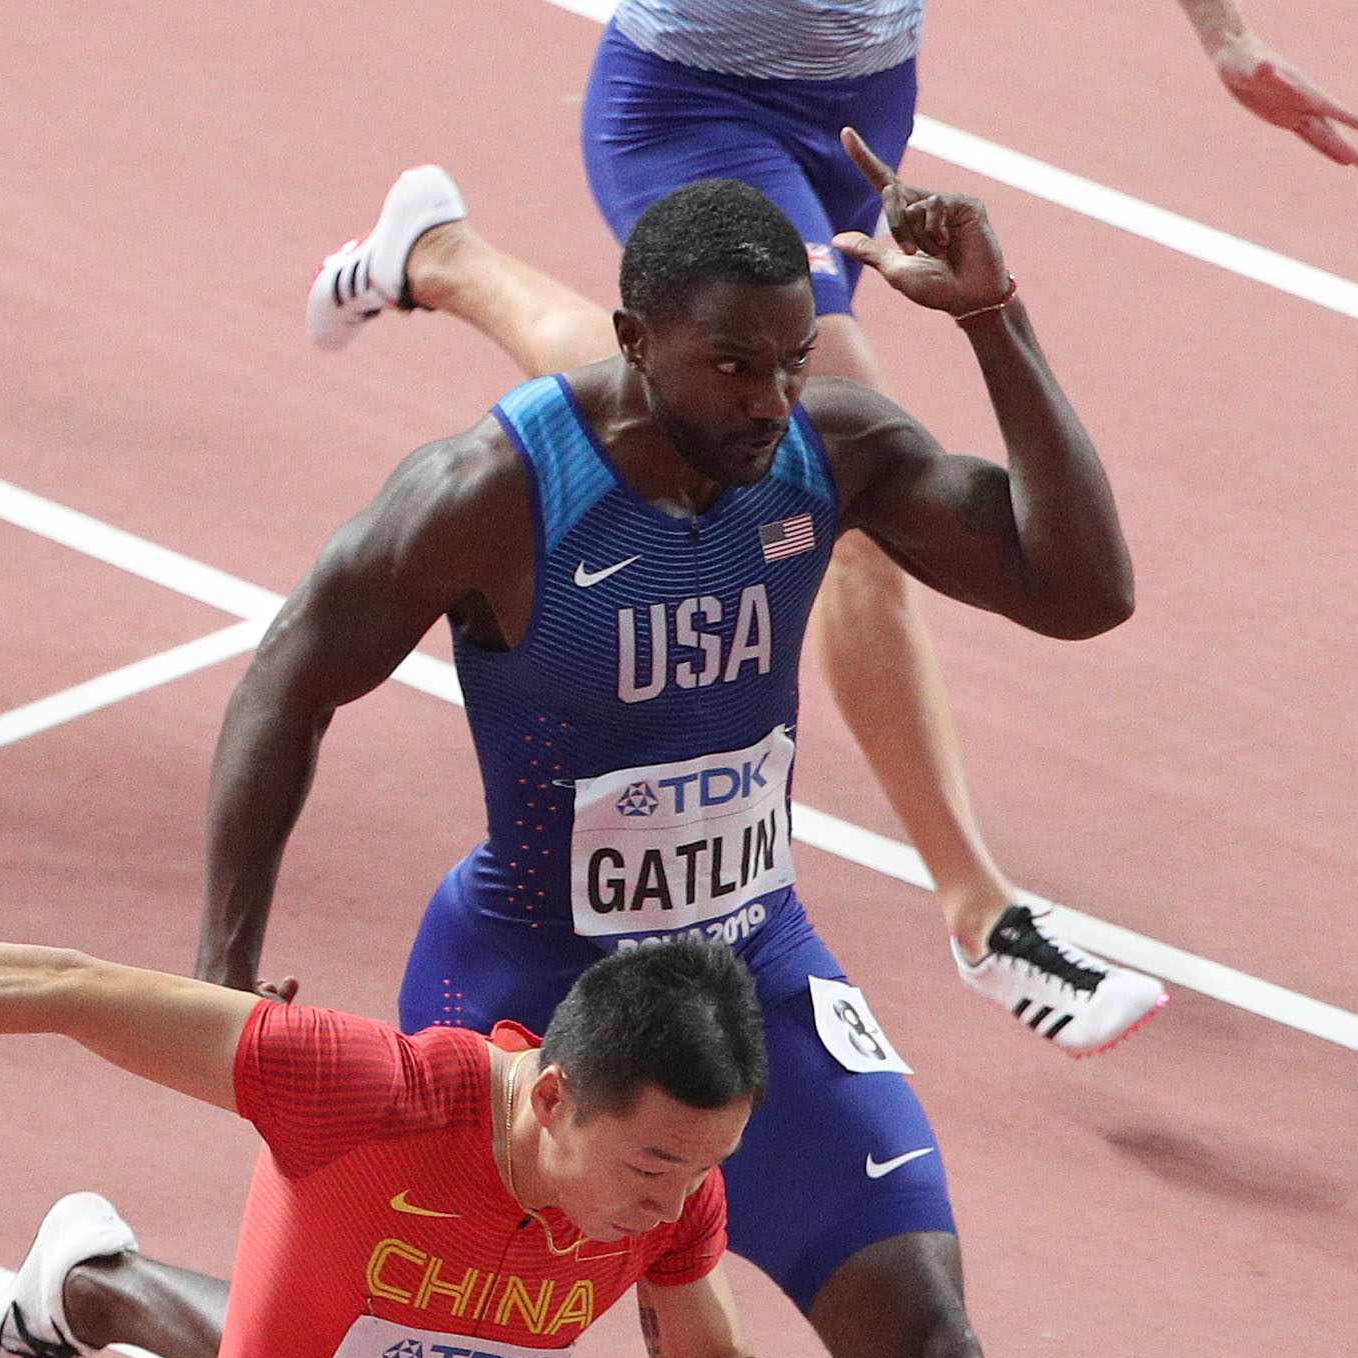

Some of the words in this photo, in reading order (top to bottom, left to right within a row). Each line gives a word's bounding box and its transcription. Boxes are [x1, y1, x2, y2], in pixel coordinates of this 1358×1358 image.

[617, 583, 773, 704] USA
[659, 752, 770, 815] TDK
[587, 808, 777, 915] GATLIN
[366, 1238, 596, 1335] CHINA
